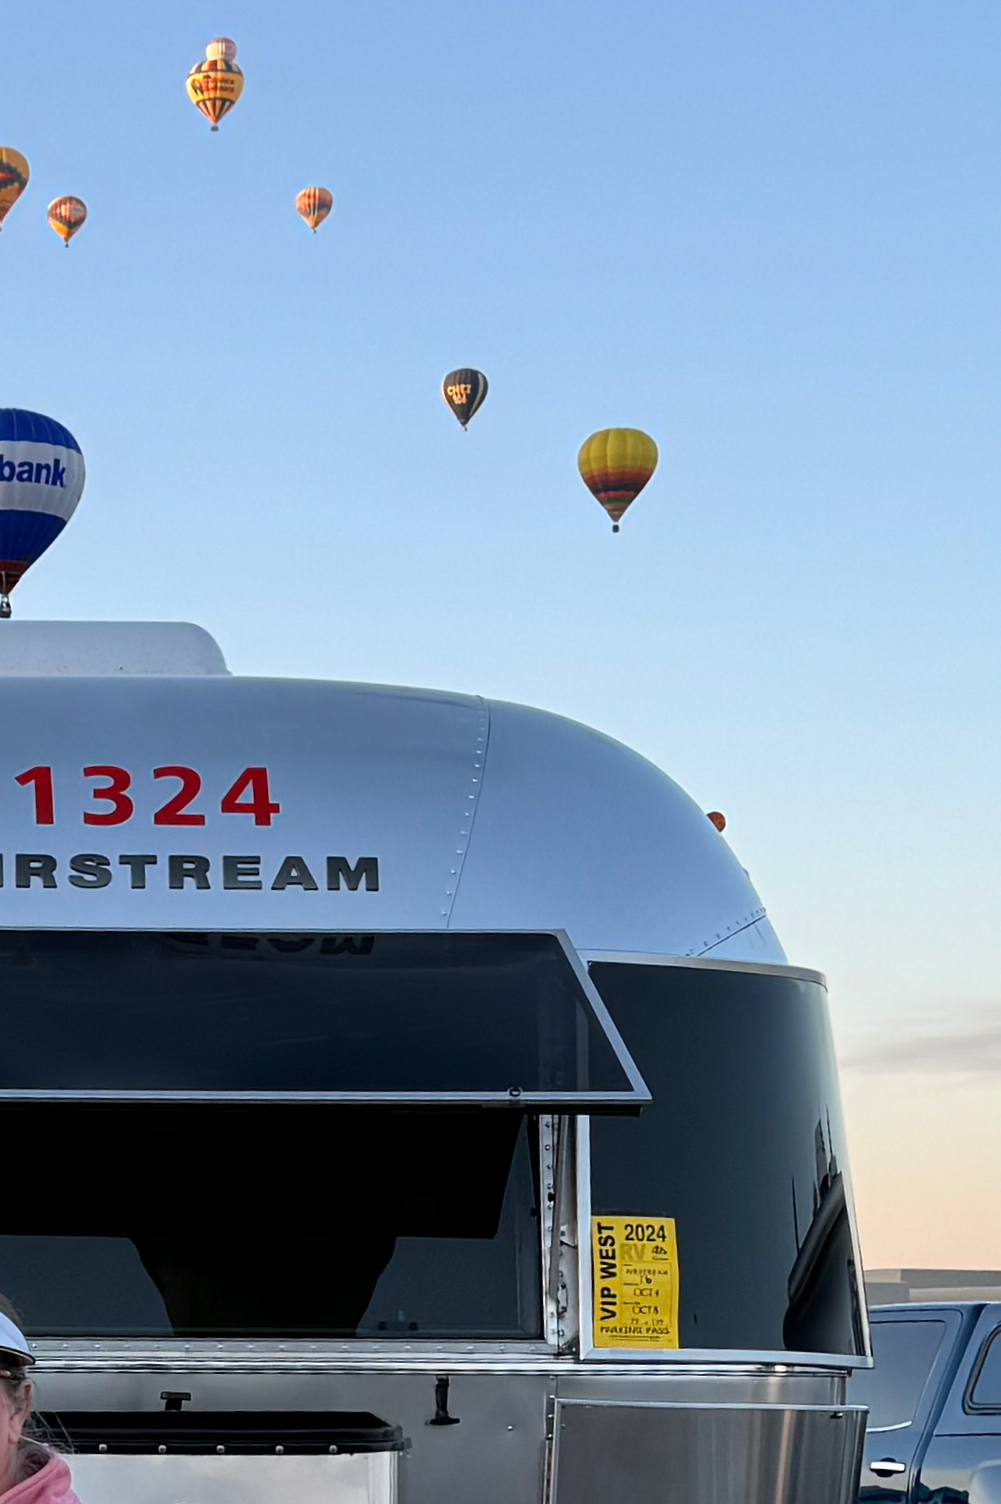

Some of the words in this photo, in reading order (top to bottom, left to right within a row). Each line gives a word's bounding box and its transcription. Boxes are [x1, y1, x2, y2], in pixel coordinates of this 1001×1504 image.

[14, 765, 280, 827] 1324
[624, 1223, 667, 1242] 2024
[597, 1222, 617, 1280] WEST
[619, 1243, 647, 1261] RV
[599, 1286, 617, 1321] VIP
